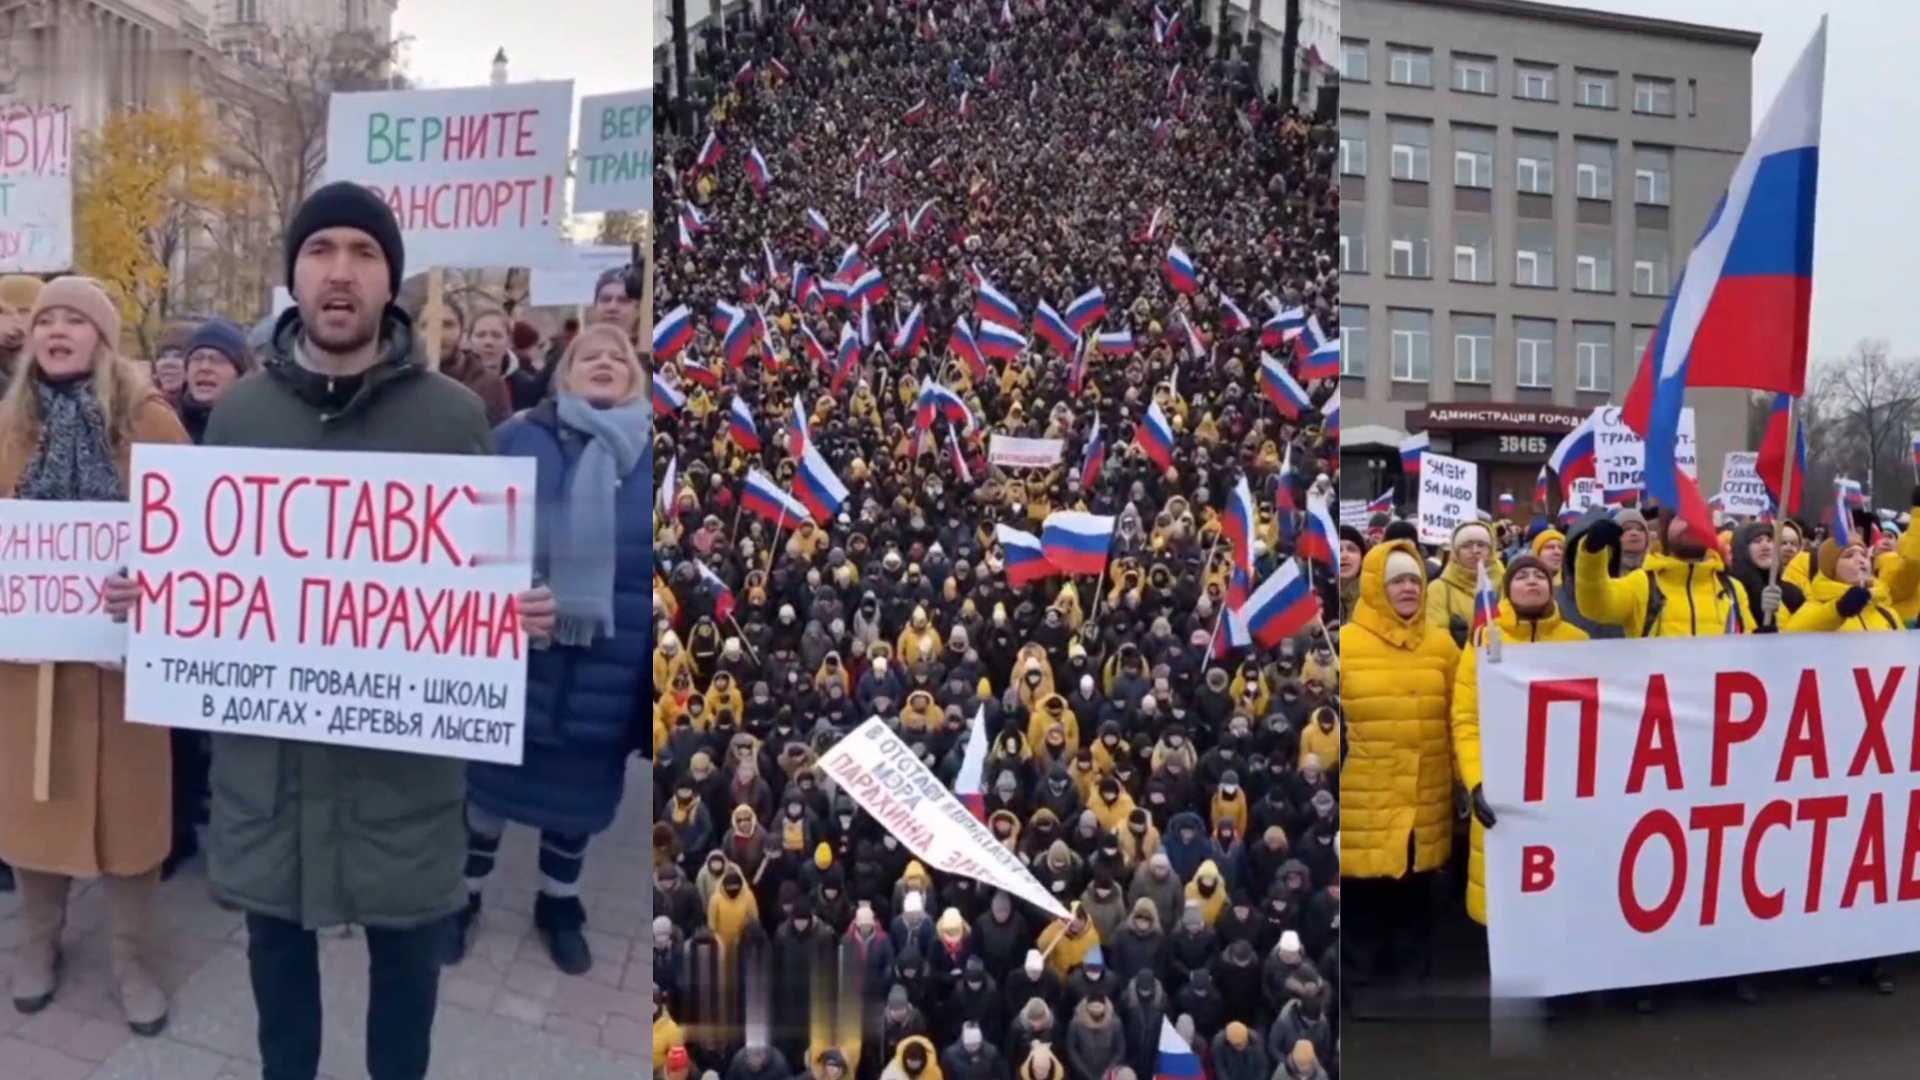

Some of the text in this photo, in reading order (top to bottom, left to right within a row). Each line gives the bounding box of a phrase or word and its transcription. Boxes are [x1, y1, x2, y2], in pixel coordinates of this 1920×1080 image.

[367, 110, 539, 164] ВЕРНИТЕ
[585, 150, 652, 184] ТРАН
[141, 471, 180, 555] В
[134, 569, 521, 661] МЭРА ПАРАХИНА
[161, 657, 509, 710] ТРАНСПОРТ ПРОВАЛЕН ШКОЛЫ
[202, 694, 516, 747] В ДОЛГАХ ДЕРЕВЬЯ ЛЫСЕЮТ
[1523, 666, 1920, 802] ПАРАХ
